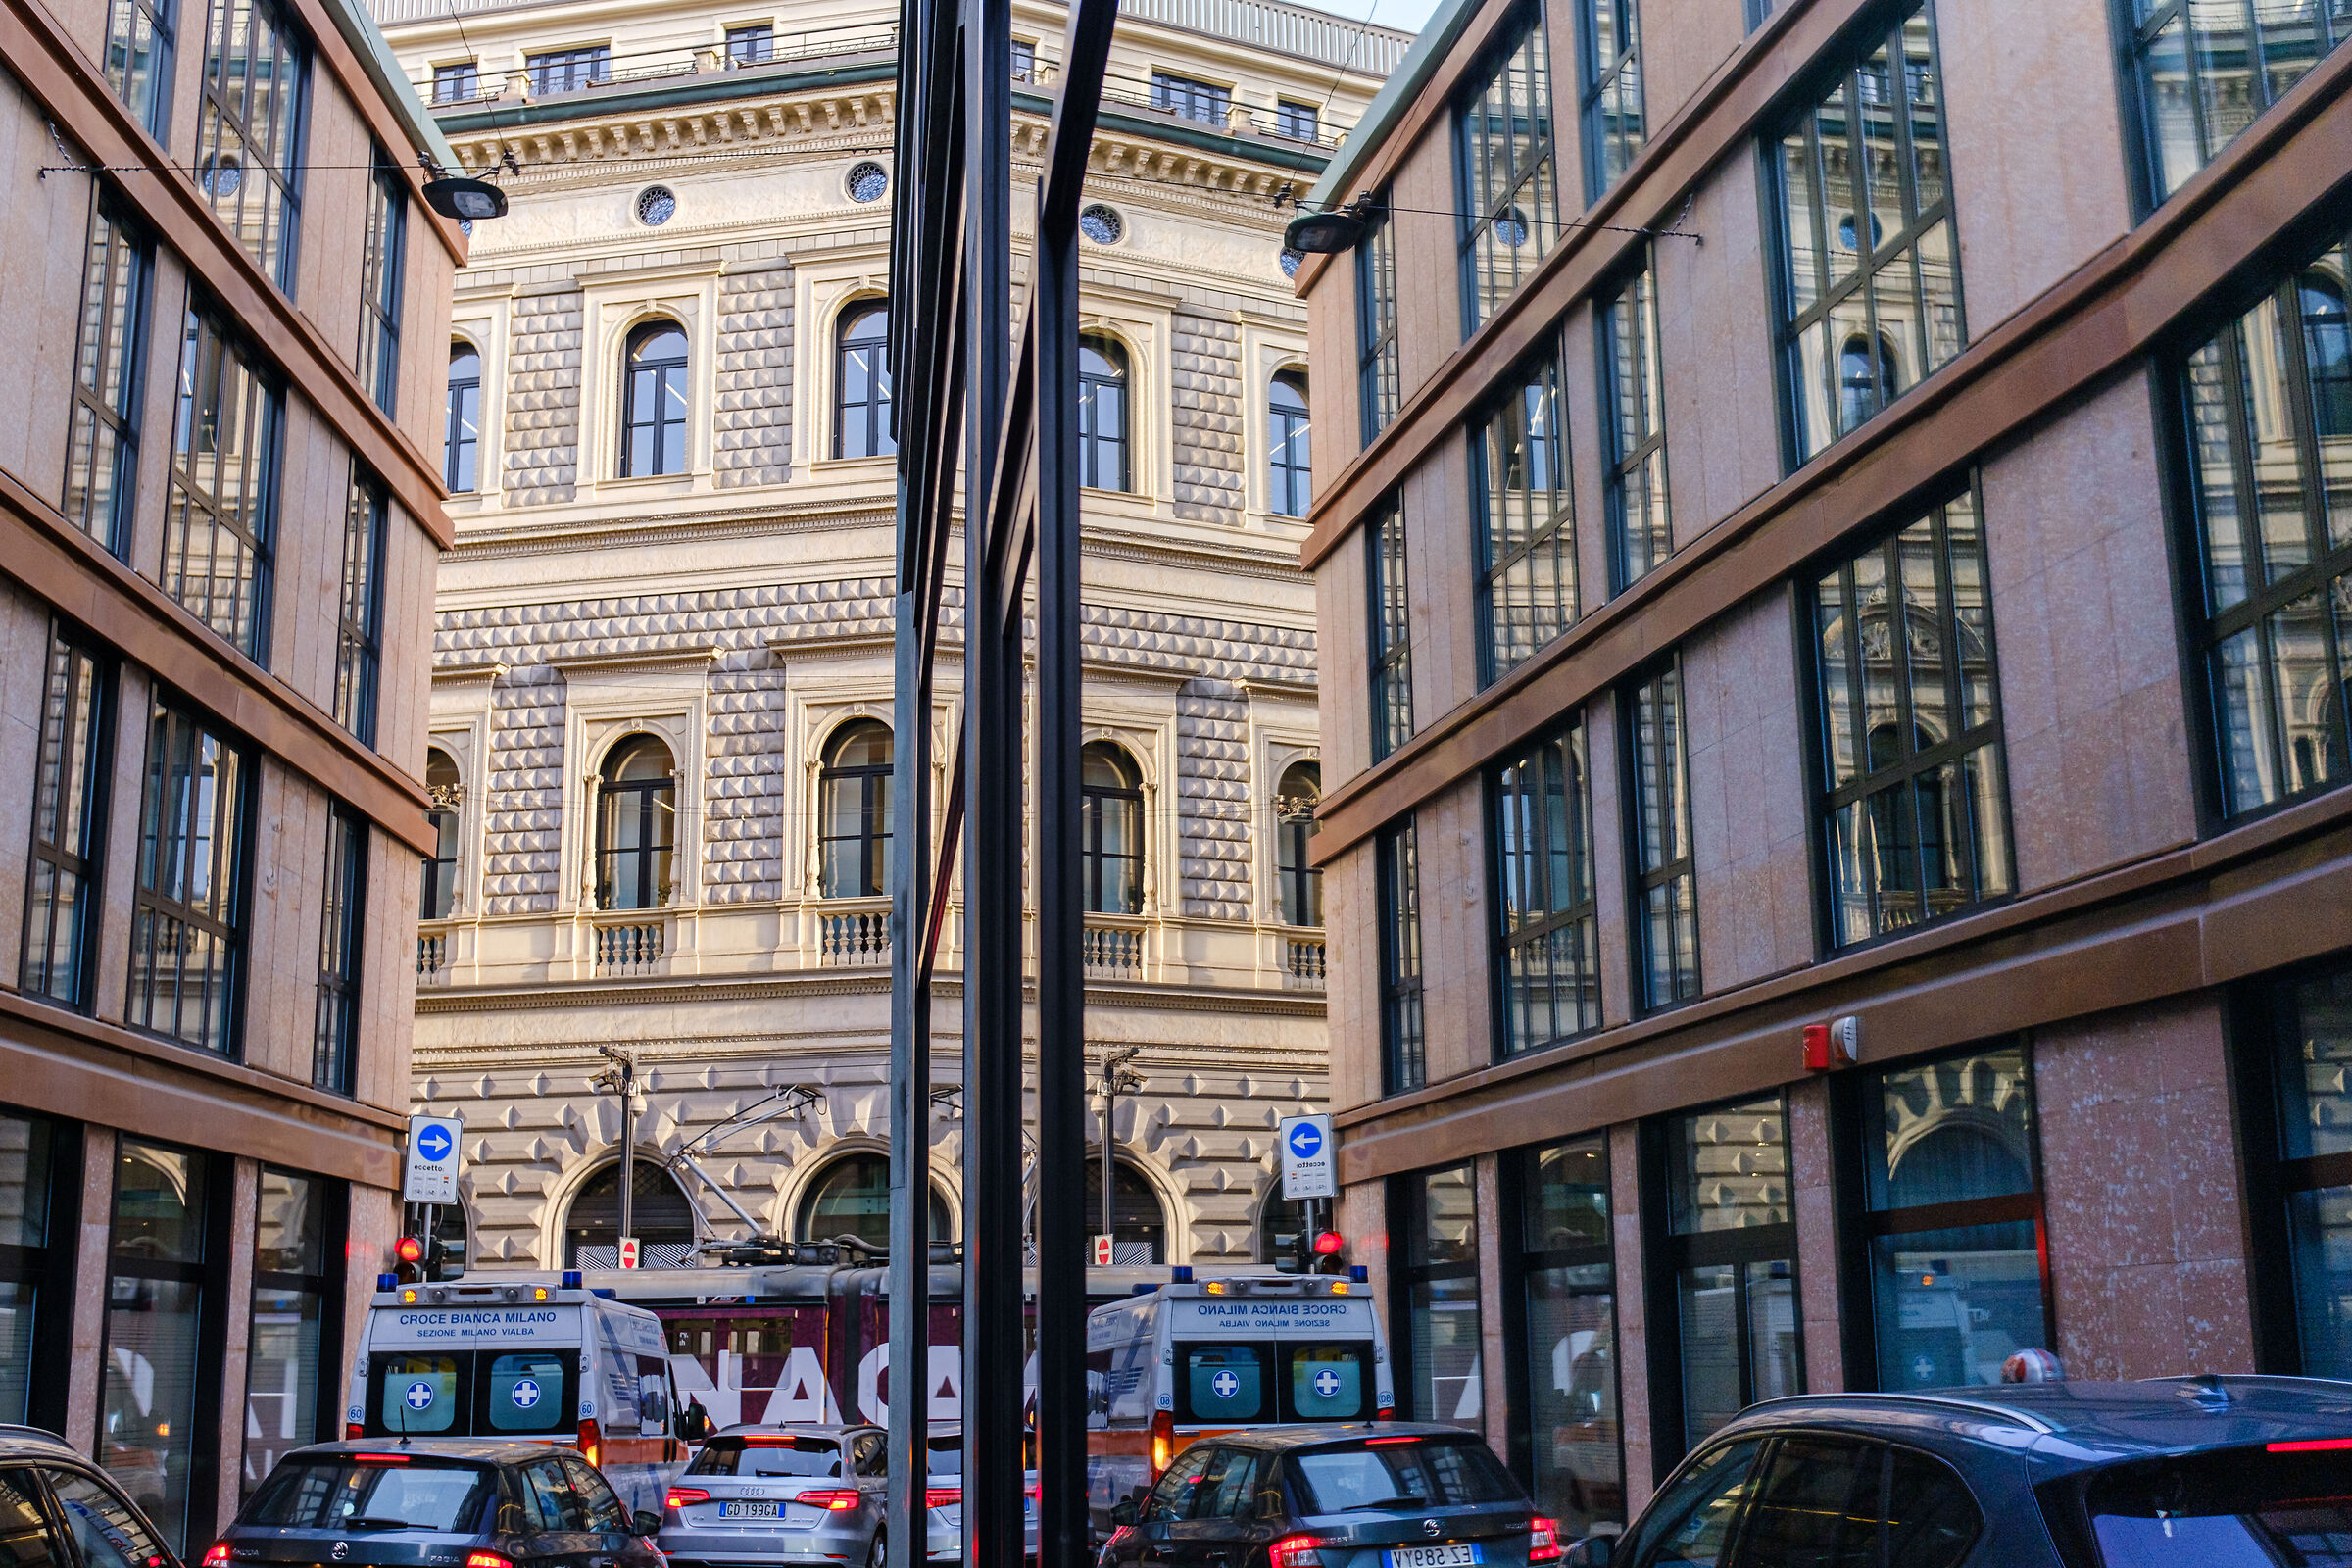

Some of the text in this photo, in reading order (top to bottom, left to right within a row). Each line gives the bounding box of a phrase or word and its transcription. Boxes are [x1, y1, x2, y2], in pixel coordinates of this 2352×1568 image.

[400, 1311, 556, 1325] CROCE BIANCA MILANO
[416, 1327, 535, 1338] SEZIONE MILANO VIALBA
[350, 1408, 362, 1418] 60
[582, 1403, 592, 1414] 60
[726, 1503, 777, 1516] GD 199GA
